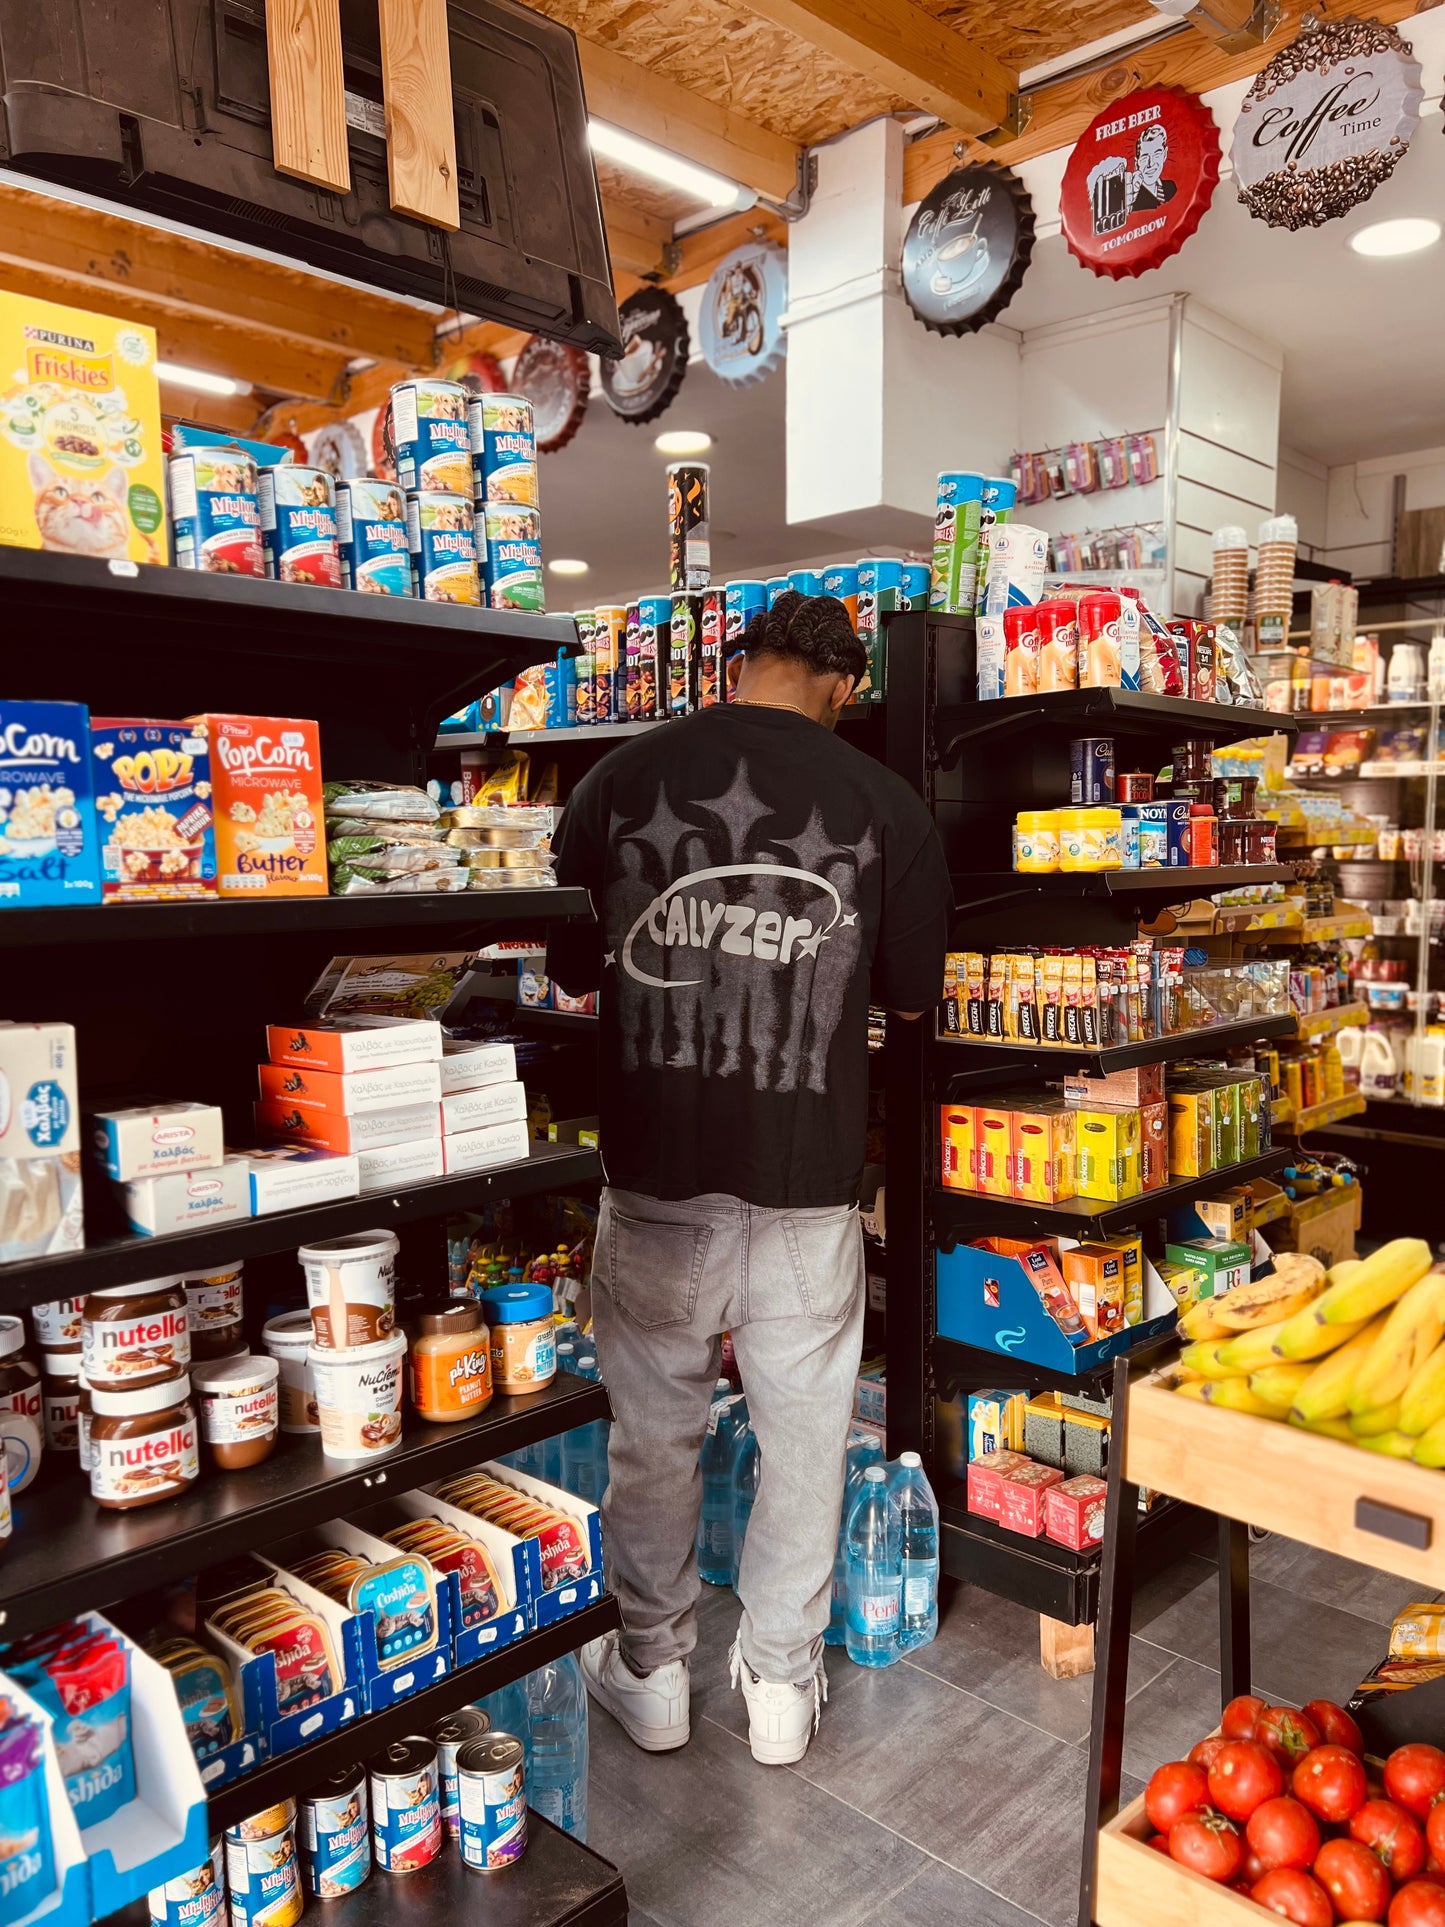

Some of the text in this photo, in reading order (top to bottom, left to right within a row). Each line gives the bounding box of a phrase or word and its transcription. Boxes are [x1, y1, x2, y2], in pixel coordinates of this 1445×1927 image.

[1095, 104, 1162, 141] FREE BEER
[1252, 71, 1380, 163] Coffee
[1340, 114, 1382, 137] Time
[1100, 215, 1167, 253] TOMORROW
[38, 330, 95, 352] PURINA
[34, 353, 109, 386] Friskies
[430, 422, 468, 442] Miglior
[495, 436, 533, 454] Miglior
[210, 496, 256, 517] Miglior
[289, 510, 331, 529] Miglior
[366, 525, 404, 542] Miglior
[433, 534, 472, 553] Miglior
[499, 543, 537, 562] Miglior
[217, 736, 314, 777] PopCorn
[111, 749, 194, 794] POPZ
[231, 776, 302, 790] MICROWAVE
[176, 806, 206, 833] PAPRIKA
[182, 815, 211, 840] FLAVOUR
[237, 853, 309, 874] Butter
[37, 1085, 51, 1142] Χαλβάς
[156, 1129, 191, 1141] ARISTA
[153, 1146, 195, 1159] Χαλβάς
[944, 1137, 952, 1178] Alokozay
[979, 1143, 987, 1184] Alokozay
[1017, 1148, 1025, 1191] Alokozay
[1080, 1147, 1090, 1190] Alokozay
[190, 1183, 220, 1194] ARISTA
[188, 1196, 224, 1210] Χαλβάς
[1226, 1268, 1241, 1290] PG
[102, 1314, 187, 1348] nutella
[459, 1379, 482, 1395] PEANUT
[461, 1388, 482, 1404] BUTTER
[235, 1392, 276, 1415] nutella
[110, 1430, 194, 1467] nutella
[376, 1582, 417, 1607] Coshida
[398, 1802, 431, 1828] Miglior
[329, 1828, 358, 1853] Miglior
[179, 1891, 215, 1919] Miglior
